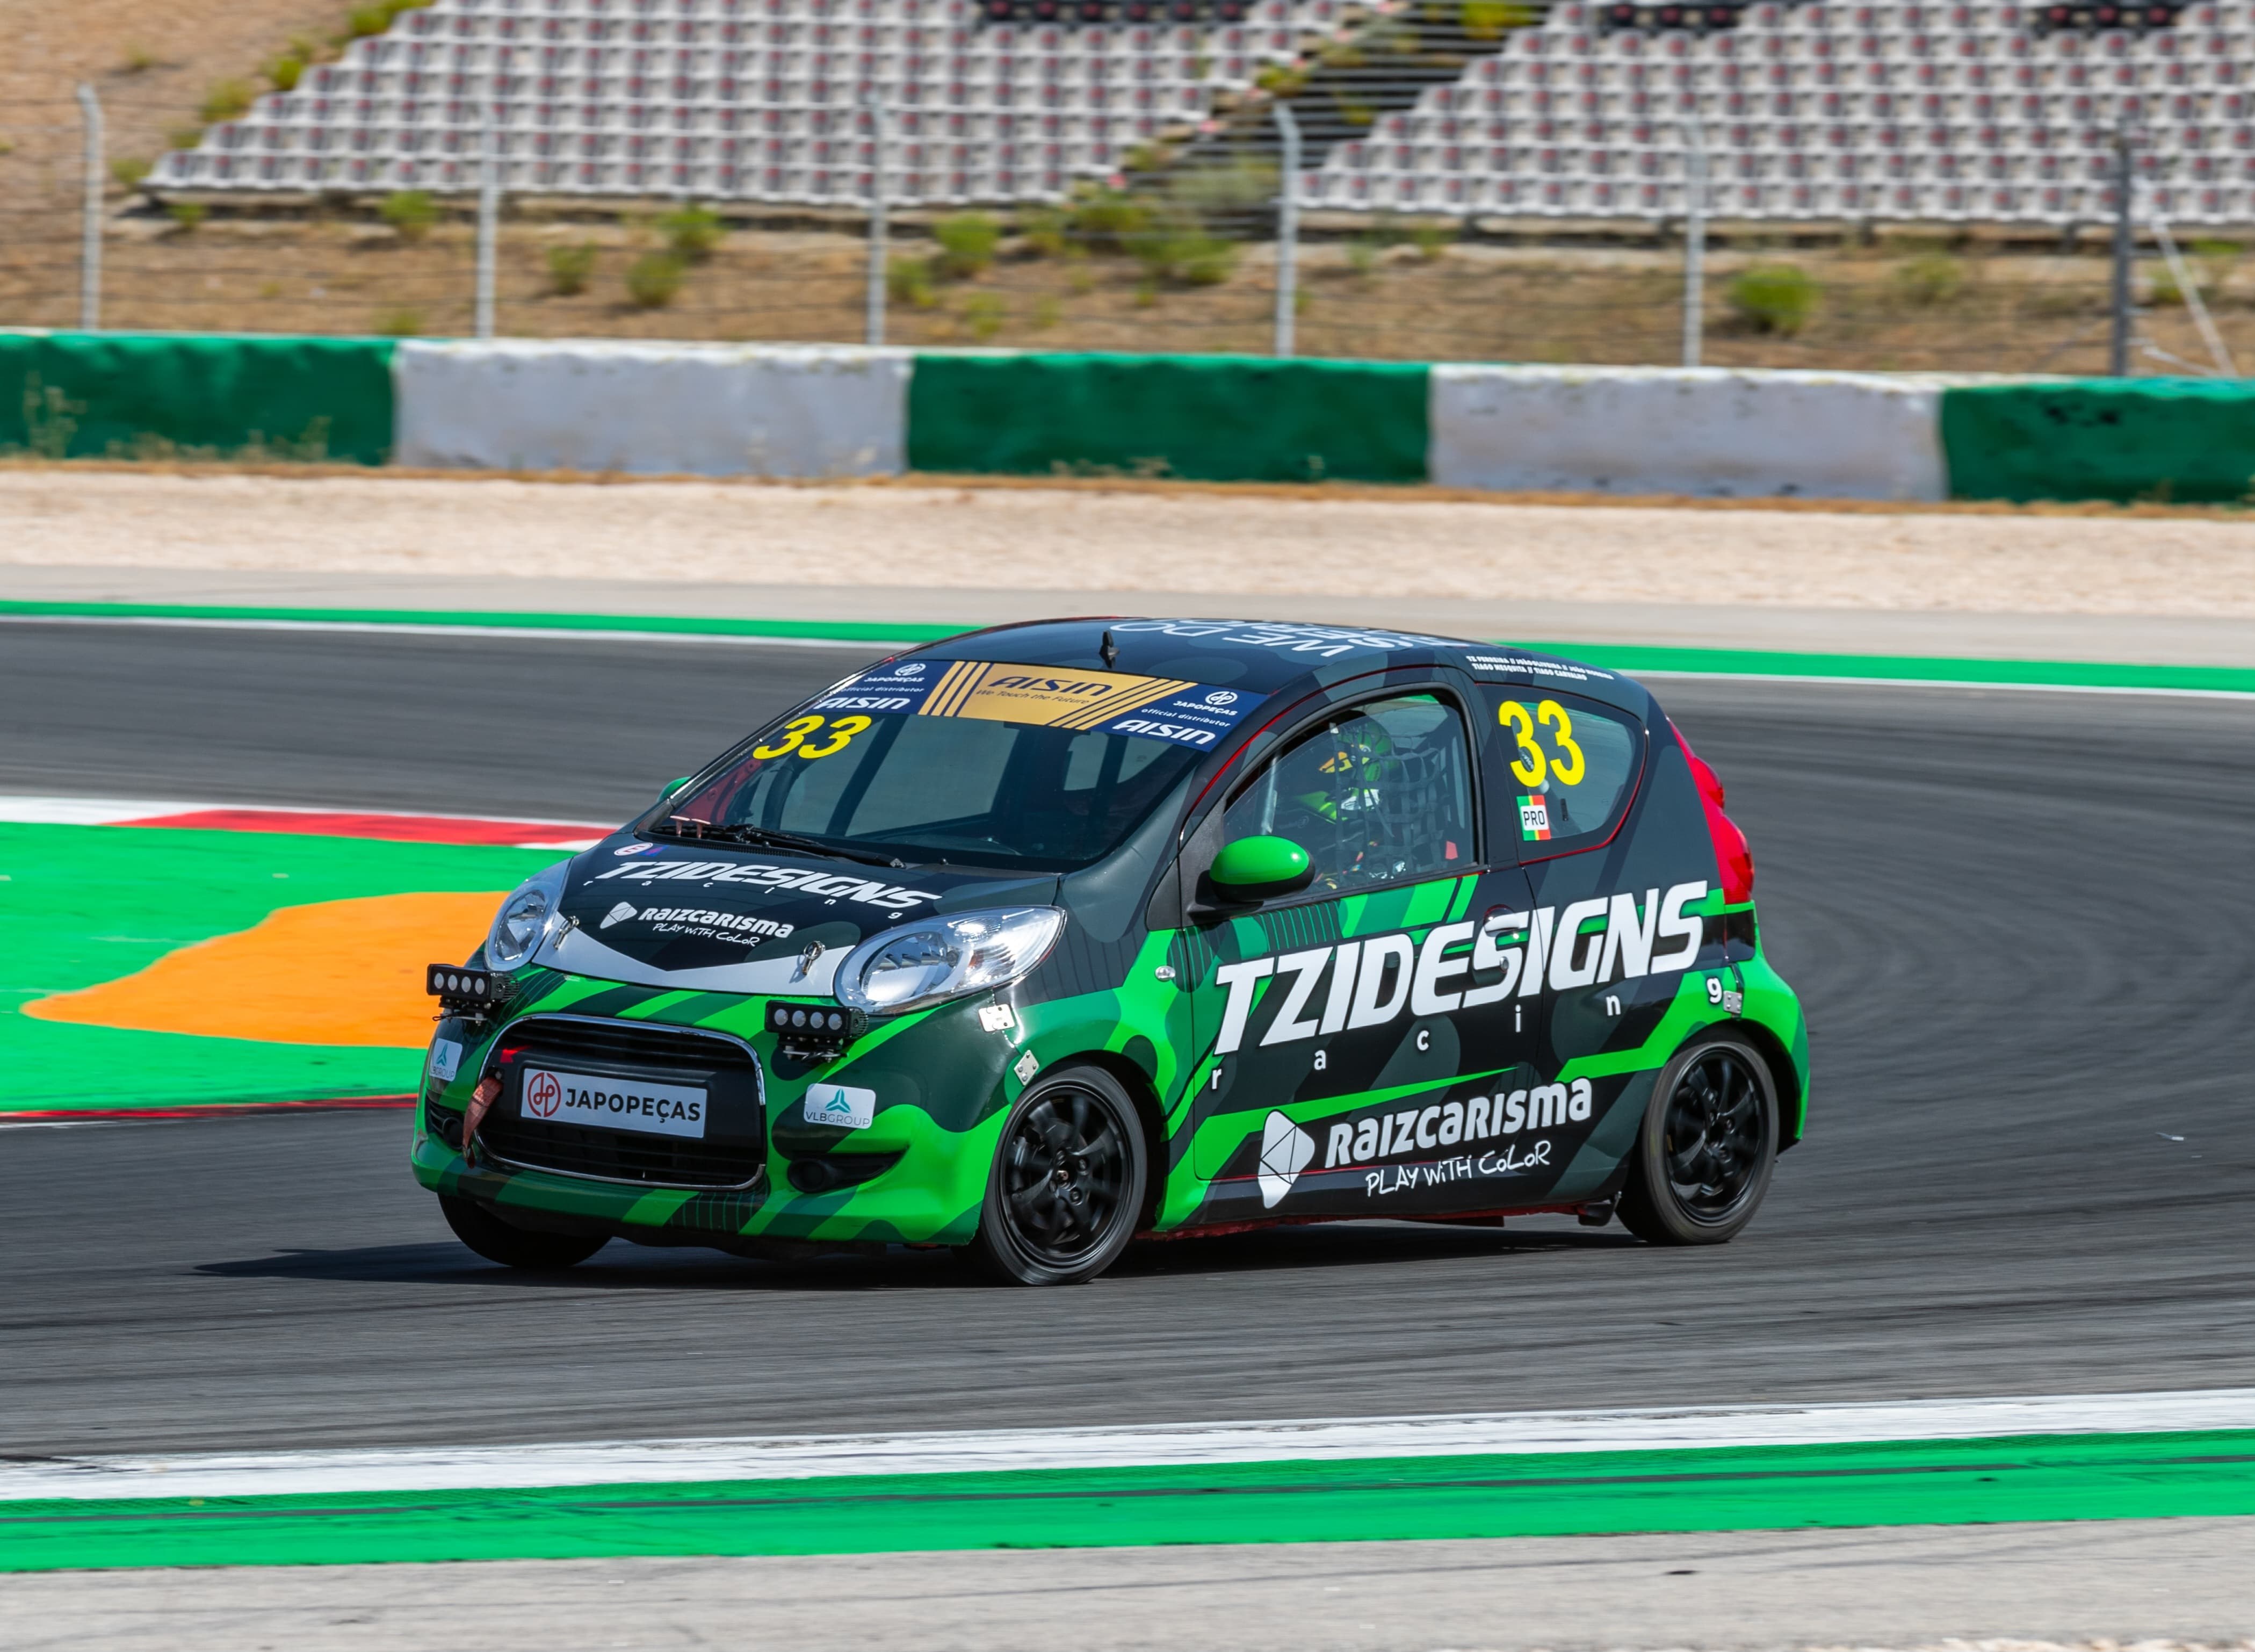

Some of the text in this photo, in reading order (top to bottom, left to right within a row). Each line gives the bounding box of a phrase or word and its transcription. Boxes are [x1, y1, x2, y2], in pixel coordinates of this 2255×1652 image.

[988, 676, 1112, 696] AISIN
[813, 697, 910, 709] AISIN
[1052, 696, 1089, 704] Future
[1173, 701, 1238, 716] JAPOPEÇAS
[1141, 708, 1231, 727] official distributor
[753, 715, 872, 759] 33
[1112, 719, 1216, 745] AISIN
[1498, 699, 1585, 787] 33
[1523, 810, 1545, 826] PRO
[595, 862, 942, 908] TZIDESIGNS
[653, 923, 684, 932] PLAY
[1214, 880, 1707, 1056] TZIDESIGNS
[565, 1088, 700, 1123] JAPOPEÇAS
[806, 1112, 870, 1126] VLBGROUP
[1365, 1165, 1419, 1197] PLAY
